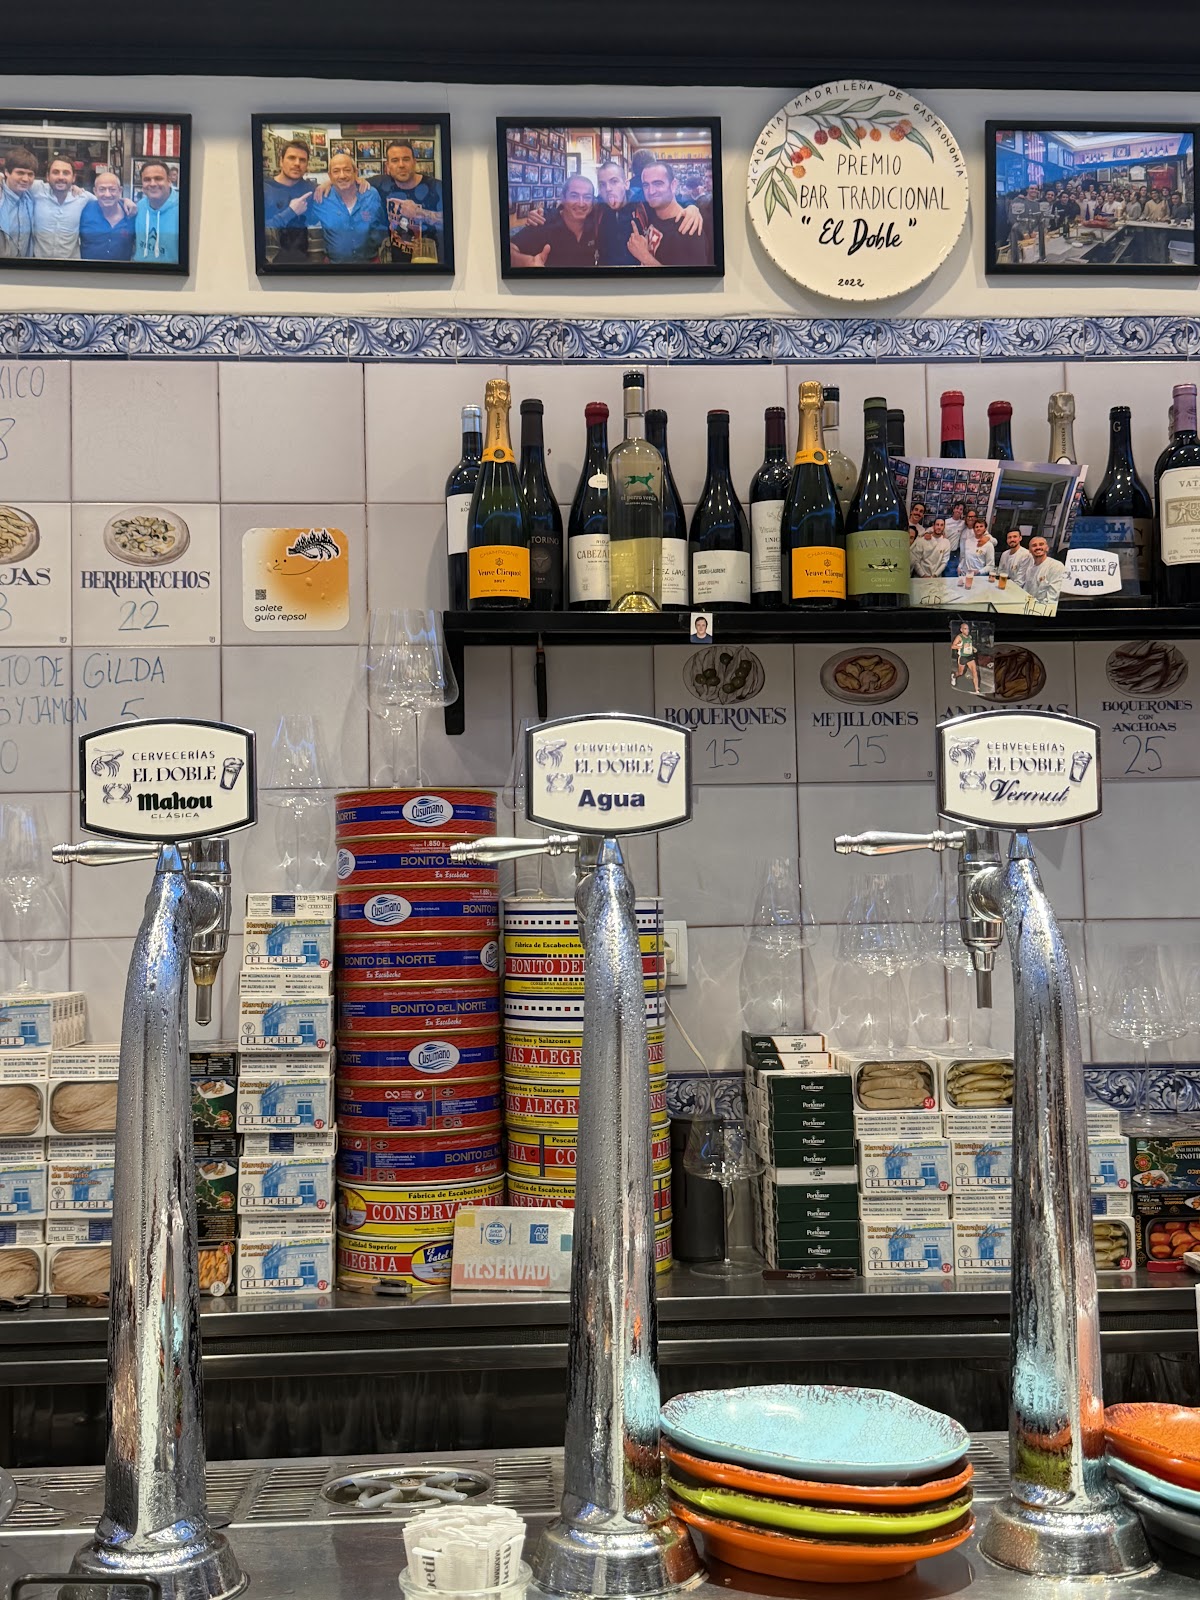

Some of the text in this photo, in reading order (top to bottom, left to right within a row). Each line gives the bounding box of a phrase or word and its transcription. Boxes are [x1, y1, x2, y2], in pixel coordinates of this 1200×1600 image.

[750, 116, 783, 185] ACADEMIA
[794, 80, 875, 109] MADRILEÑA
[888, 89, 904, 101] DE
[836, 153, 902, 176] PREMIO
[800, 184, 951, 211] BAR TRADICIONAL
[837, 278, 865, 288] 2022
[1179, 480, 1200, 488] VAT
[478, 569, 495, 577] Veuve
[81, 570, 211, 597] BERBERECHOS
[1074, 578, 1104, 588] Agua
[118, 600, 169, 631] 22
[278, 613, 307, 621] repsol
[35, 655, 64, 687] DE
[83, 653, 165, 689] GILDA
[1102, 700, 1193, 715] BOQUERONES
[664, 707, 787, 732] BOQUERONES
[812, 711, 919, 738] MEJILLONES
[1112, 722, 1177, 732] ANCHOAS
[574, 742, 653, 753] CERVECERÍAS
[705, 738, 743, 769] 15
[844, 734, 889, 767] 15
[986, 741, 1066, 752] CERVECERÍAS
[132, 750, 216, 761] CERVECERÍAS
[1122, 735, 1166, 775] 25
[575, 758, 654, 774] EL DOBLE
[988, 757, 1066, 773] EL DOBLE
[133, 766, 216, 782] EL DOBLE
[989, 778, 1072, 804] Vermut
[137, 792, 213, 811] Mahou
[578, 789, 645, 811] Agua
[151, 811, 200, 819] CLÁSICA
[411, 804, 443, 819] Cusumano
[400, 856, 444, 866] BONITO
[371, 903, 401, 918] Cusumano
[463, 905, 492, 914] BONITO
[345, 955, 436, 966] BONITO DEL NORTE
[512, 959, 554, 974] BONITO
[391, 1001, 487, 1014] BONITO DEL NORTE
[263, 1036, 299, 1044] DOBLE
[418, 1049, 450, 1065] Cusumano
[525, 1099, 577, 1114] ALEGR
[261, 1116, 297, 1124] DOBLE
[445, 1150, 482, 1163] BONITO
[887, 1179, 921, 1187] DOBLE
[977, 1177, 1011, 1185] DOBLE
[448, 1188, 483, 1197] Escabeches
[538, 1185, 576, 1194] Escabeches
[263, 1197, 298, 1205] DOBLE
[341, 1251, 398, 1272] ALEGRIA
[463, 1255, 560, 1280] RESERVADO
